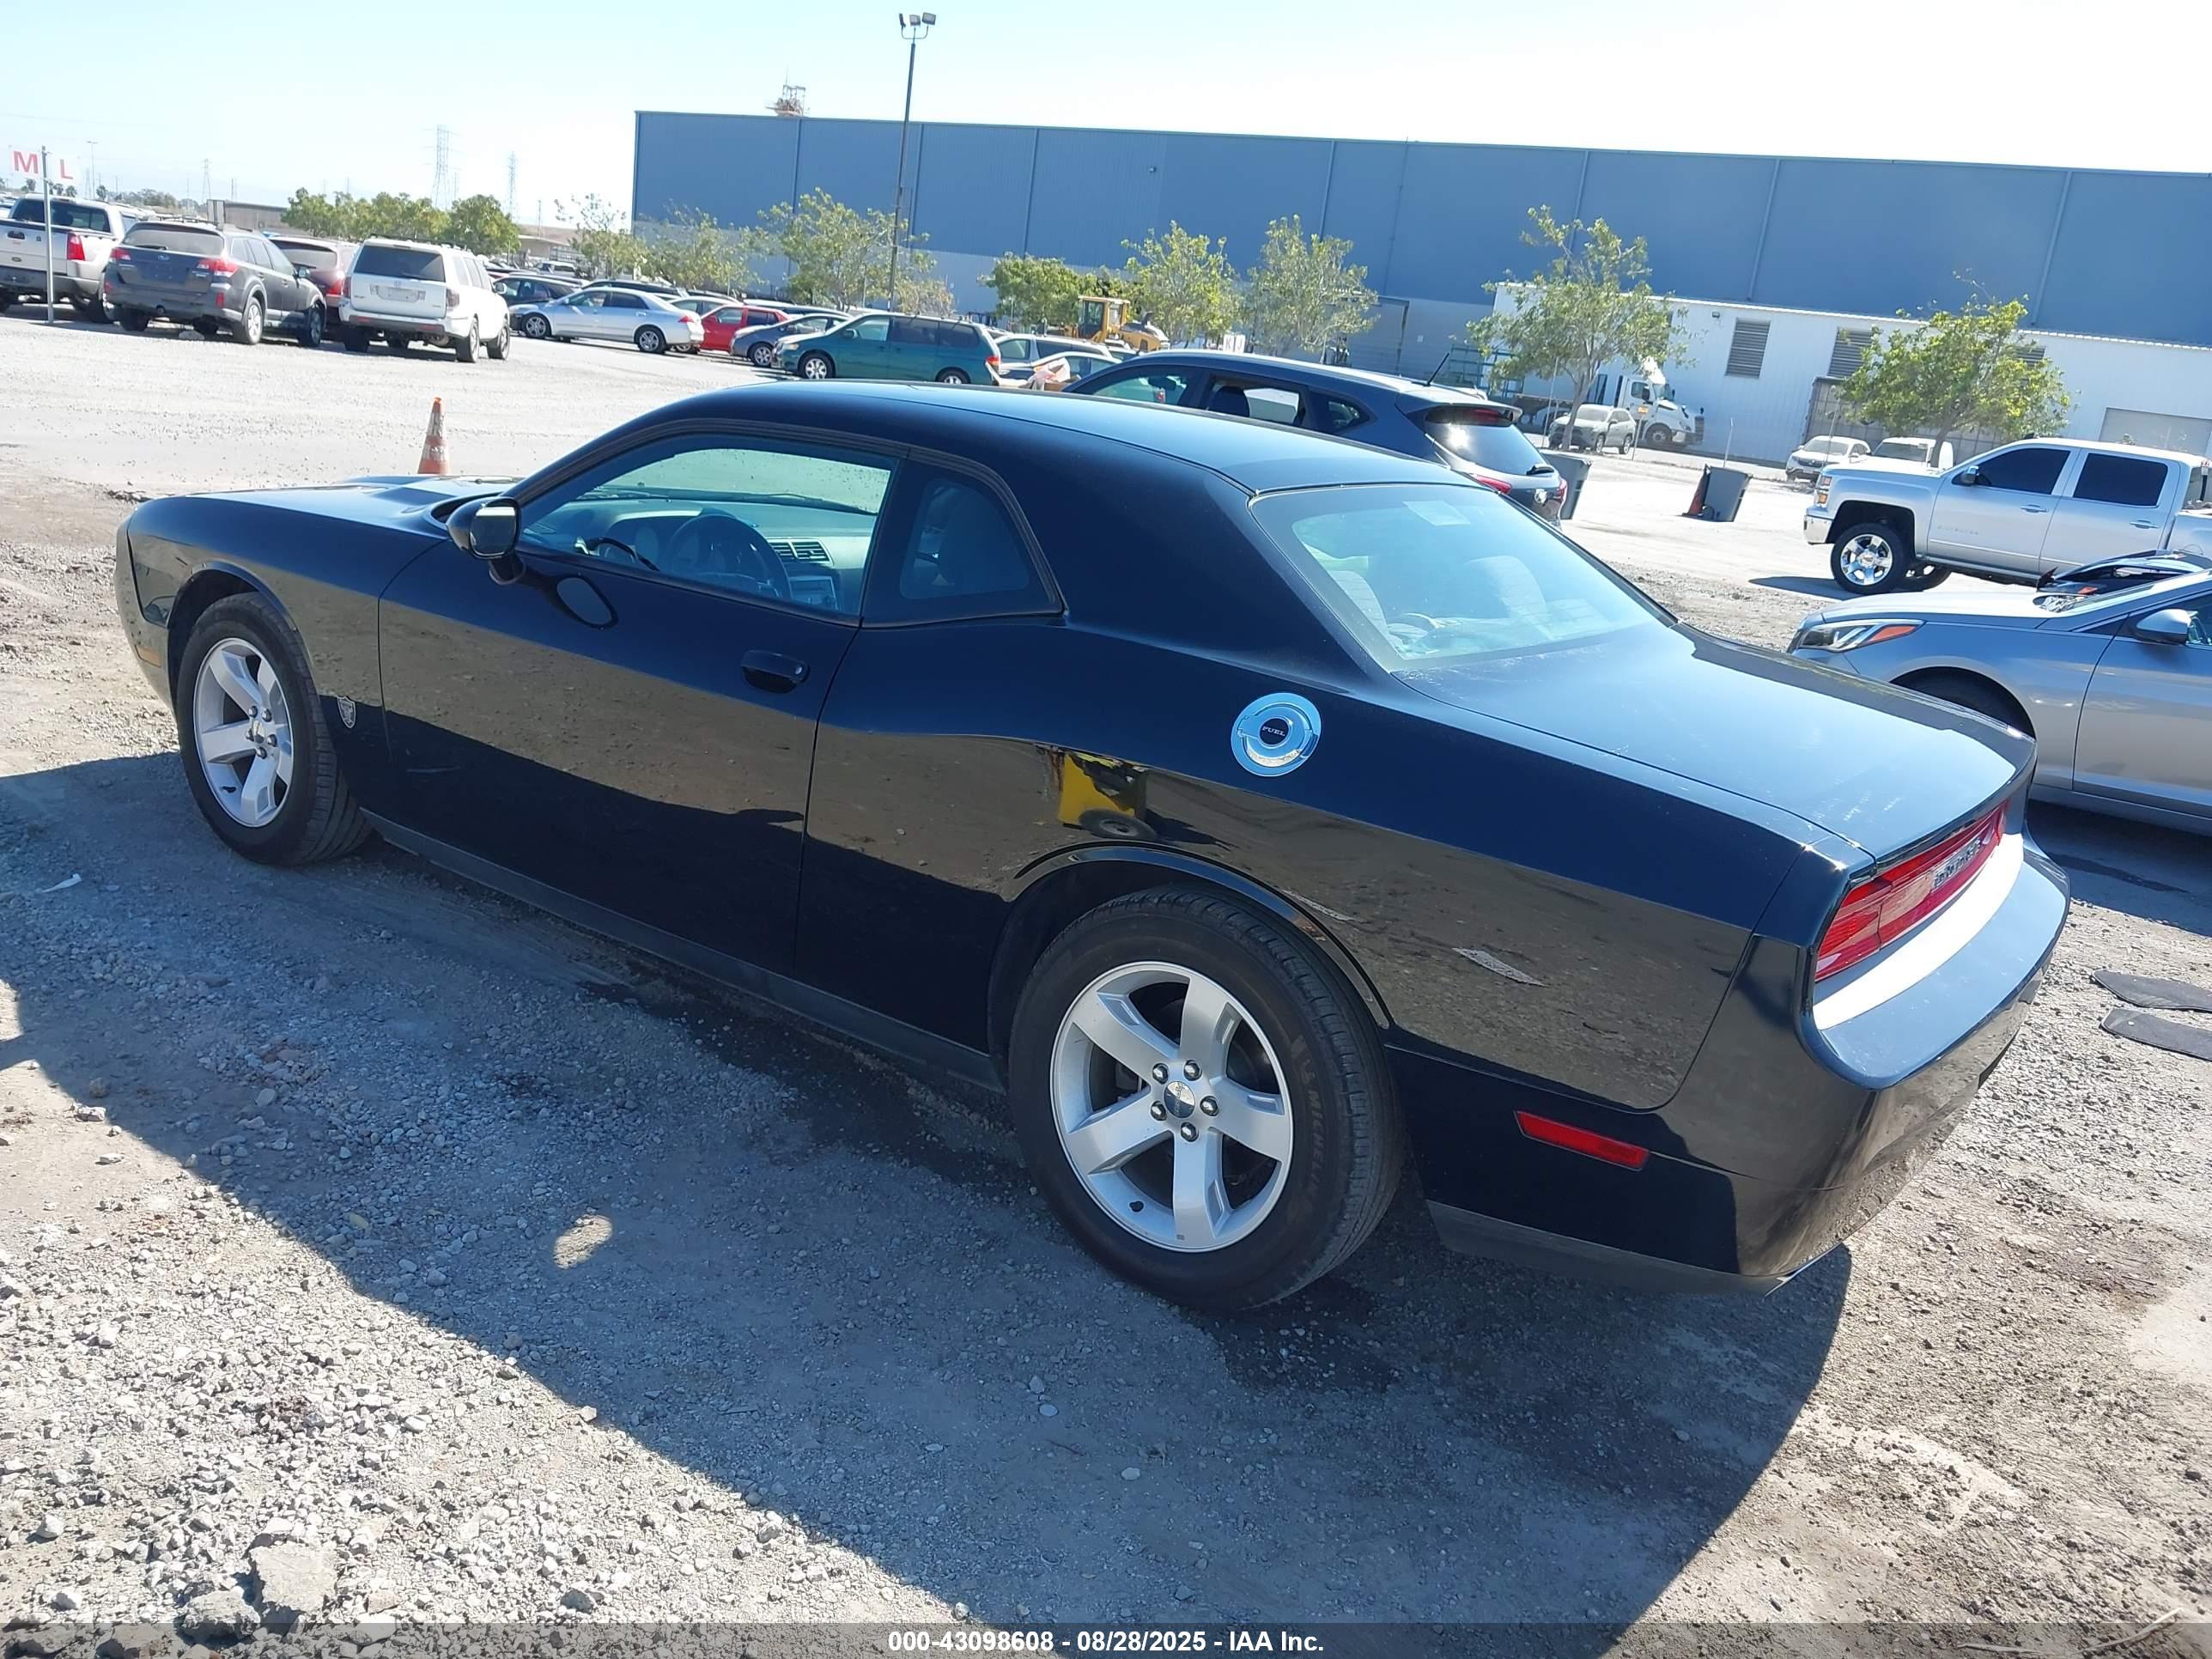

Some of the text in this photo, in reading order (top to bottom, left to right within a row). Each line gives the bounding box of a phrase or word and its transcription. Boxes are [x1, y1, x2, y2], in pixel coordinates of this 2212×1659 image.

[14, 150, 39, 174] M
[59, 159, 74, 179] L
[1261, 726, 1285, 737] FUEL
